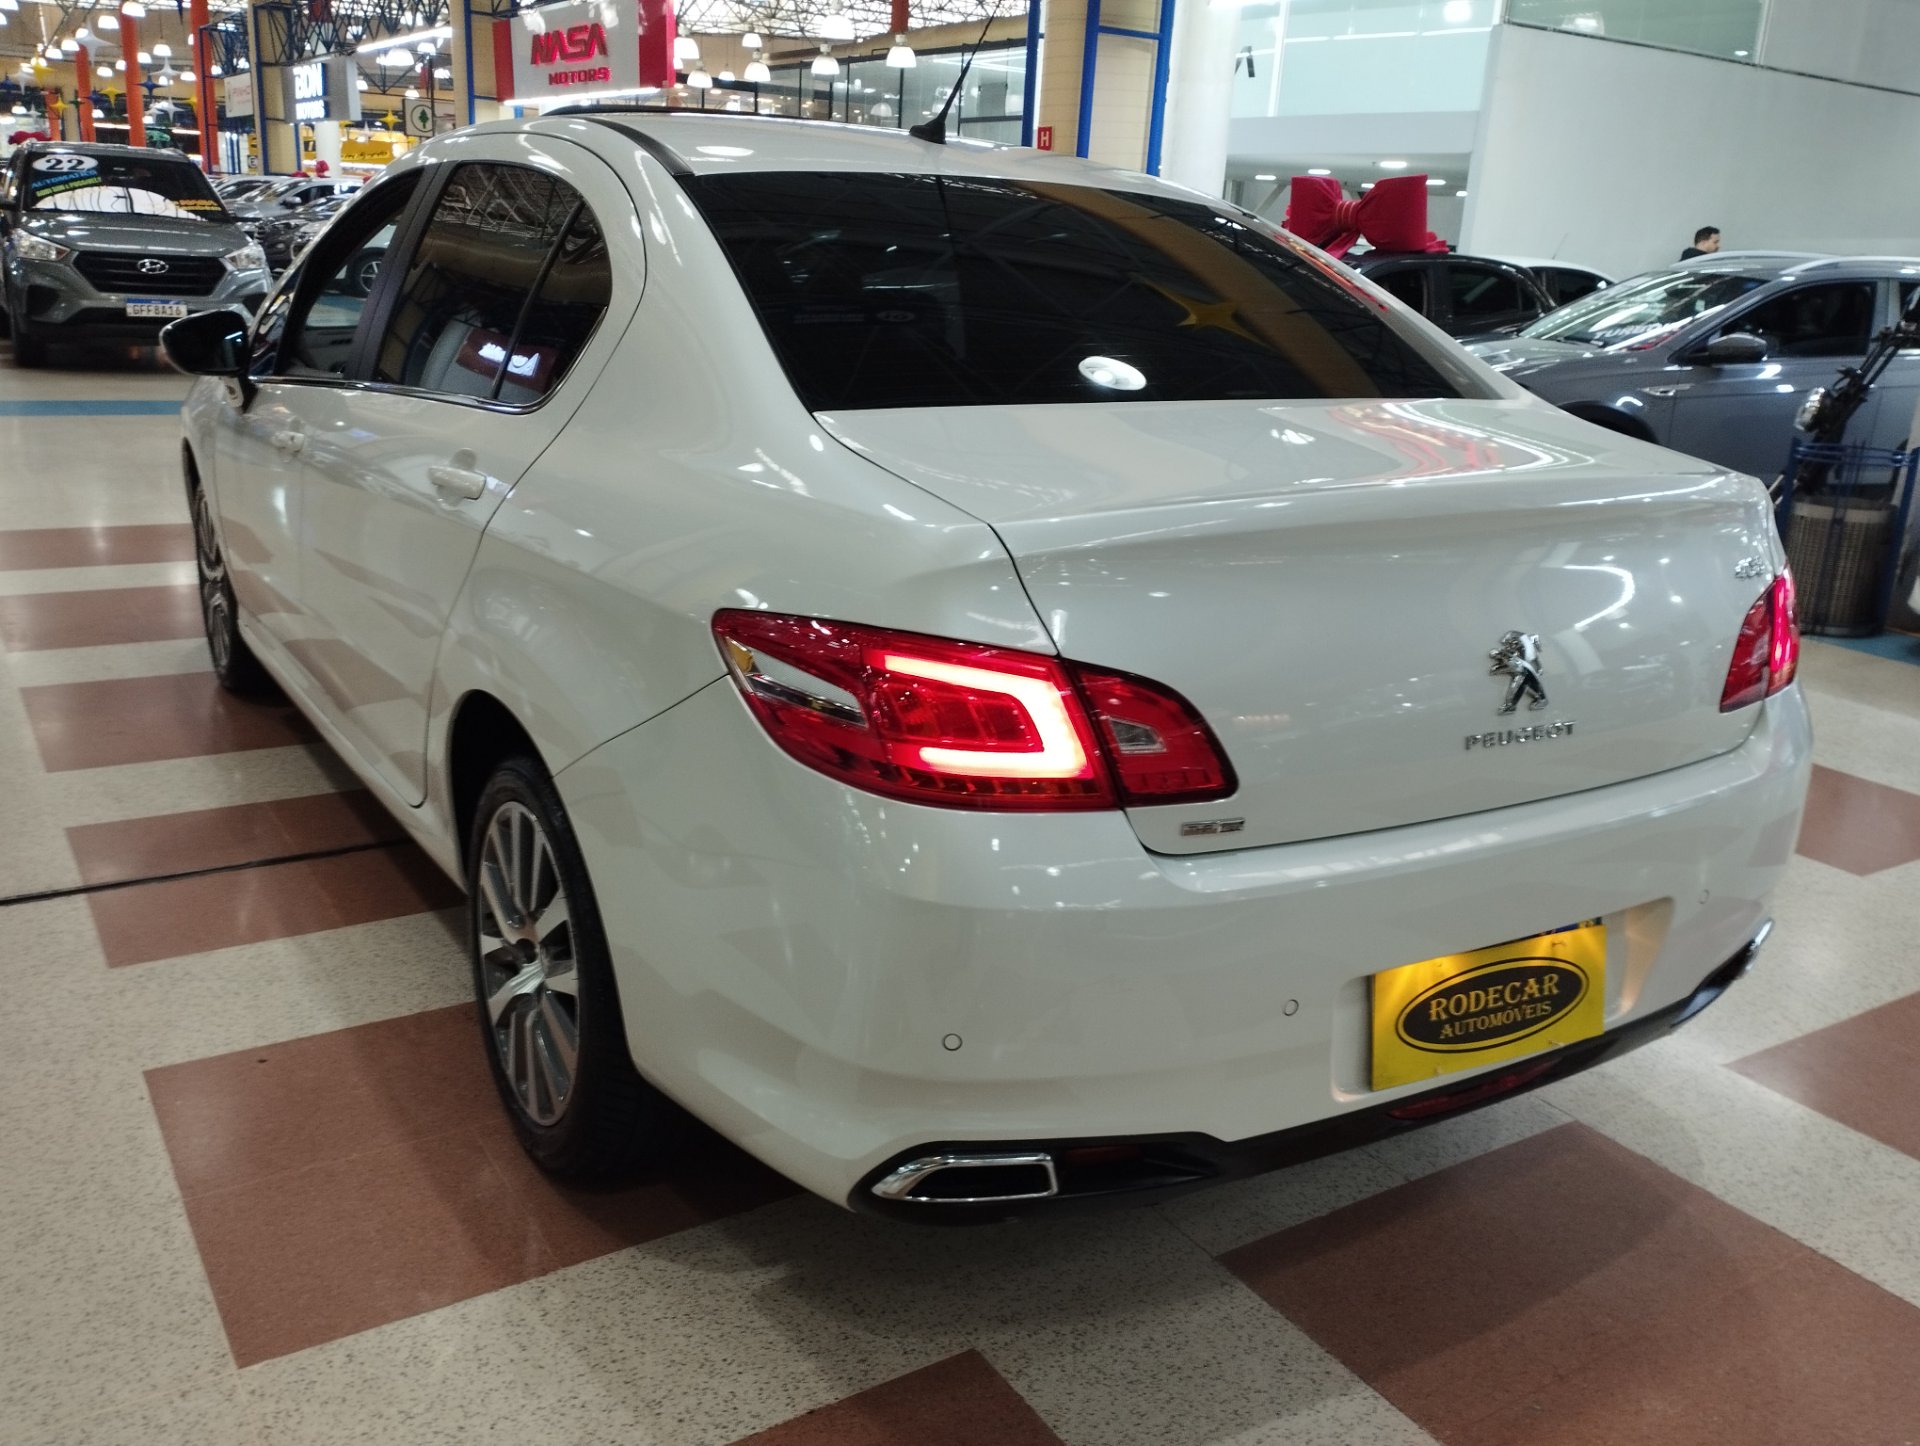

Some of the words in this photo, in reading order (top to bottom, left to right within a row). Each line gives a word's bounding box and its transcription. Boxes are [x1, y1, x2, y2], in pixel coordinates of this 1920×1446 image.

[531, 23, 608, 65] NASA
[548, 67, 611, 85] MOTORS
[1040, 131, 1050, 147] H
[45, 158, 85, 171] 22
[1464, 721, 1576, 750] PEUGEOT
[1429, 973, 1559, 1022] RODECAR
